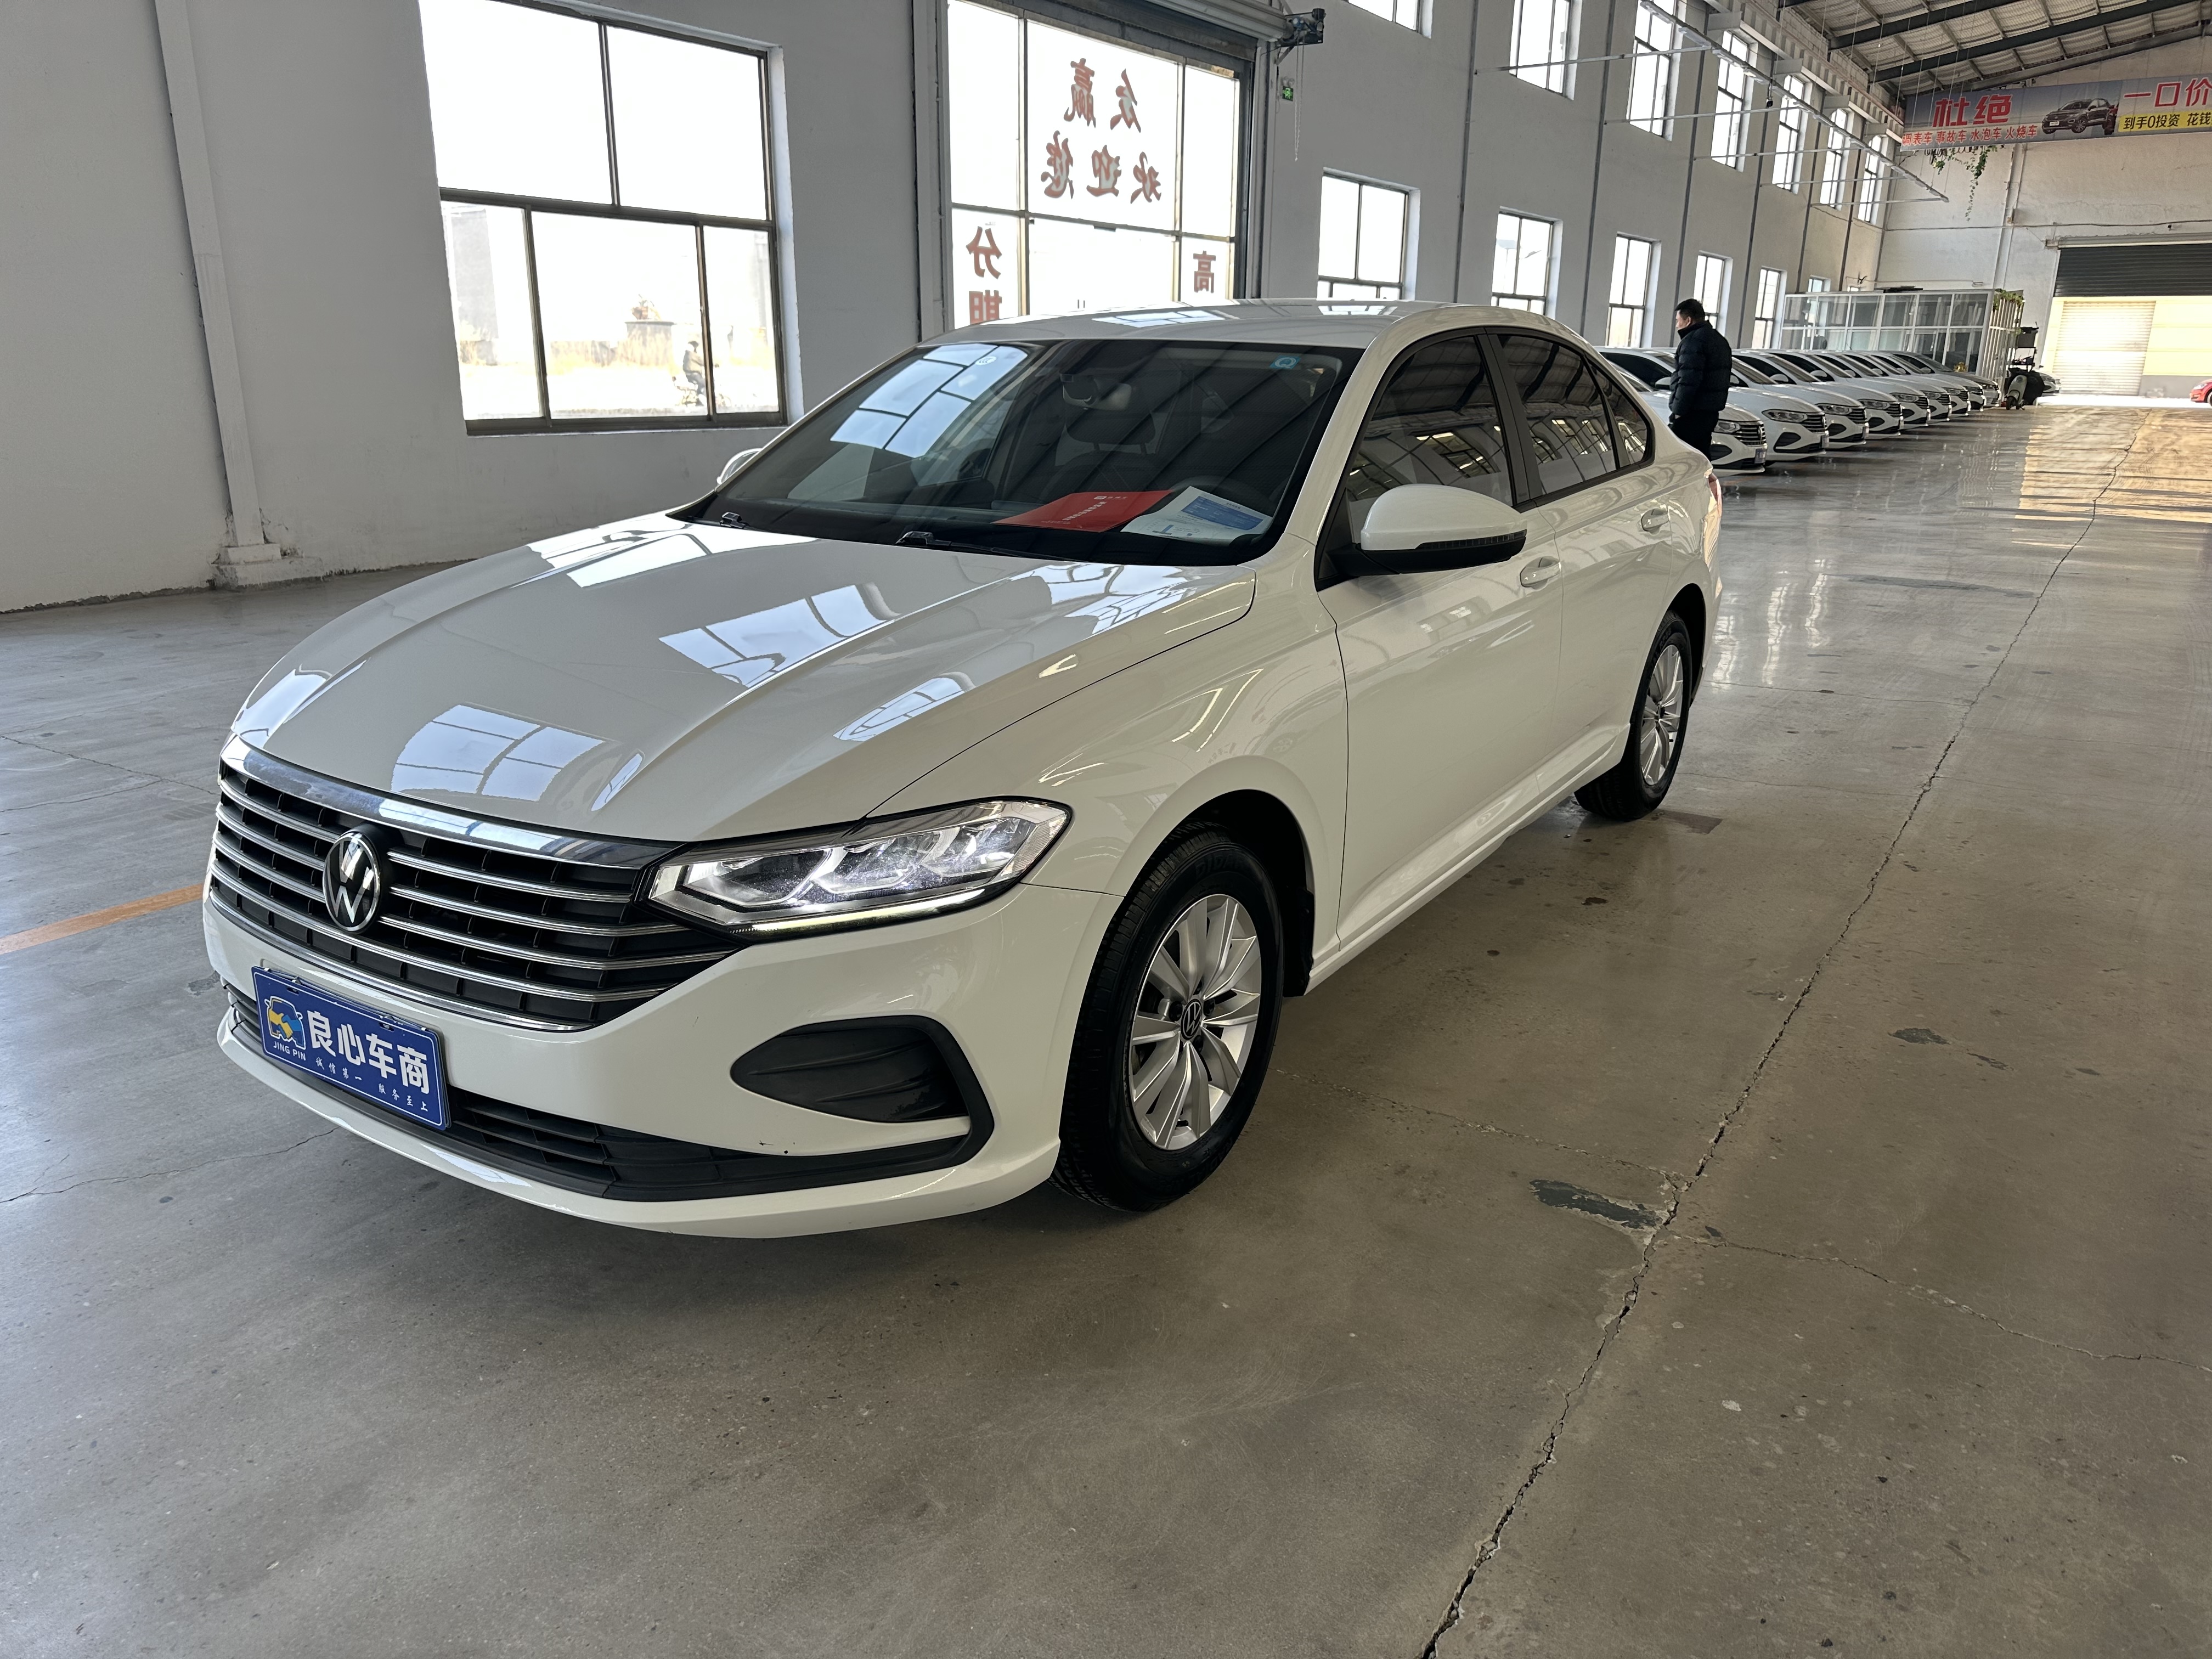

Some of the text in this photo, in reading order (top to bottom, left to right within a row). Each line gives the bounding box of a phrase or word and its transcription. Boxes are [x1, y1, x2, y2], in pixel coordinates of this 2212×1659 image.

[2124, 77, 2212, 107] 一口价
[1932, 94, 2012, 127] 杜绝
[2123, 114, 2180, 129] 到手0投资
[1936, 129, 1967, 143] 事故车
[1970, 127, 2002, 142] 水泡车
[2005, 124, 2038, 139] 火烧车
[273, 1040, 306, 1061] JING PIN
[307, 1009, 430, 1094] 良心车商
